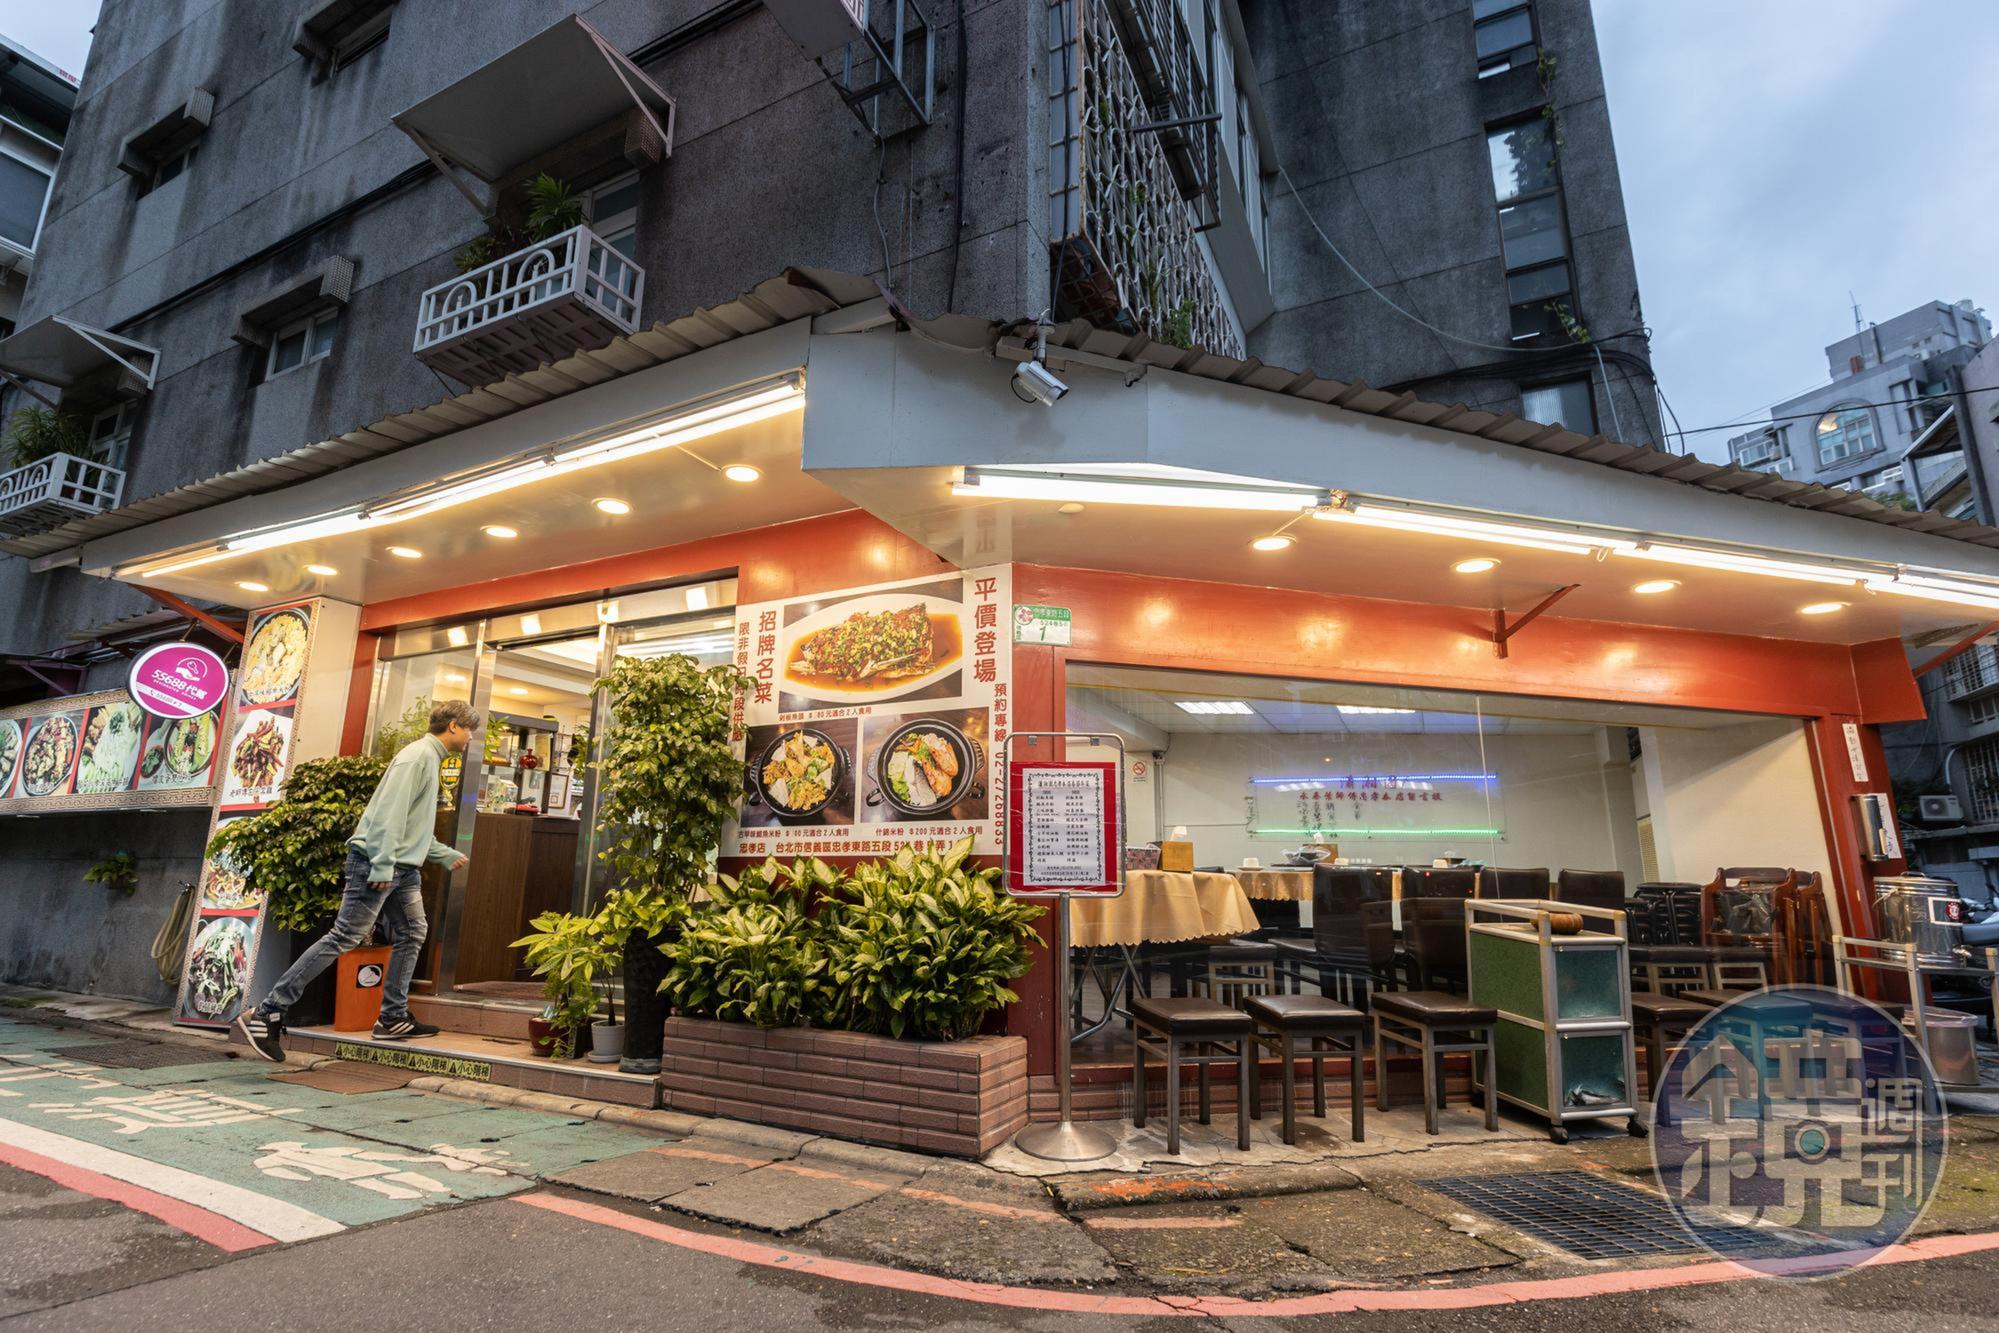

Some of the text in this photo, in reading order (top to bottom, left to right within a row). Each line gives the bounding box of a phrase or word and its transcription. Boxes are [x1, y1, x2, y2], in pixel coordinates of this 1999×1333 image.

[973, 576, 997, 684] 平價登場
[754, 610, 777, 705] 招牌名菜
[994, 683, 1007, 743] 預約專線
[739, 842, 766, 854] 忠孝店
[342, 1045, 370, 1060] 小心階梯
[378, 1050, 408, 1066] 小心階梯
[416, 1056, 449, 1071] 小心階梯
[457, 1062, 490, 1077] 小心階梯
